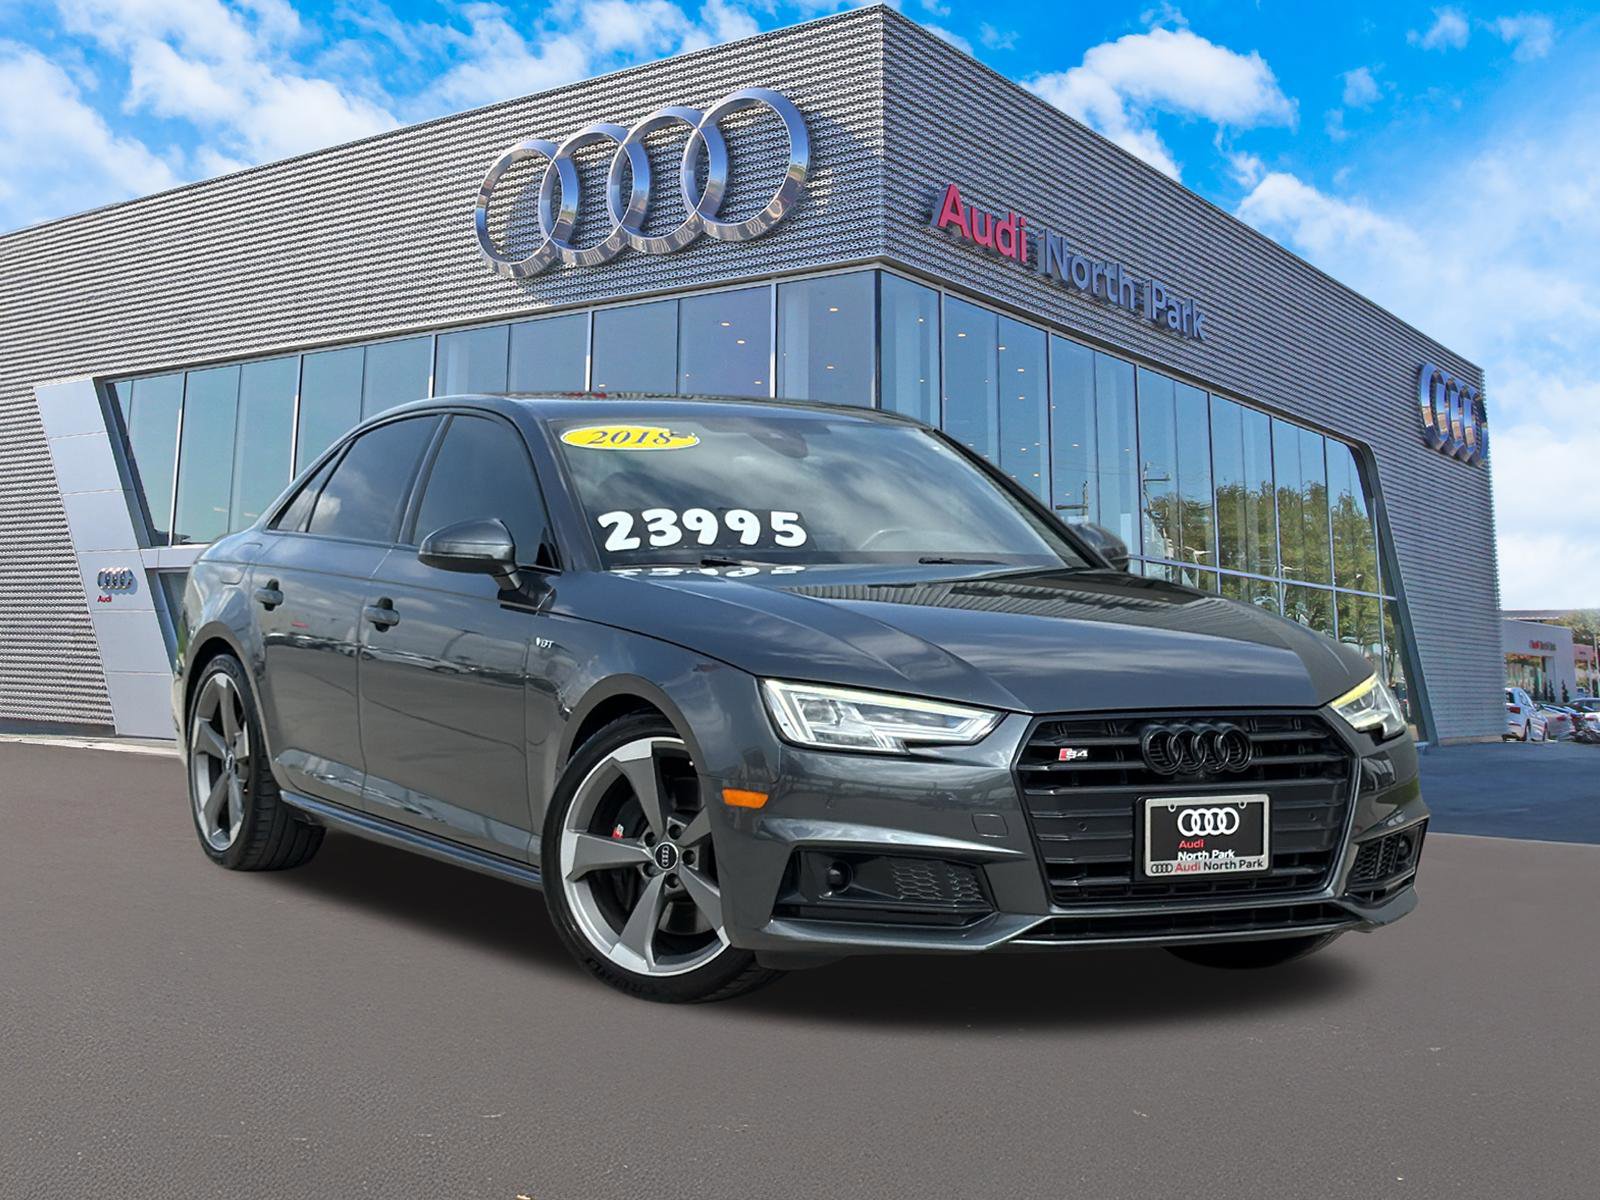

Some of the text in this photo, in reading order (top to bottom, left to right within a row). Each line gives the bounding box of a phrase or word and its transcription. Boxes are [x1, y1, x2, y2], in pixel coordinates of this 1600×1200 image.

[935, 183, 1207, 340] Audi North Park
[587, 430, 671, 445] 2018
[597, 508, 807, 551] 23995
[1179, 839, 1205, 848] Audi
[1177, 849, 1235, 861] North Park
[1175, 858, 1263, 873] Audi North Park
